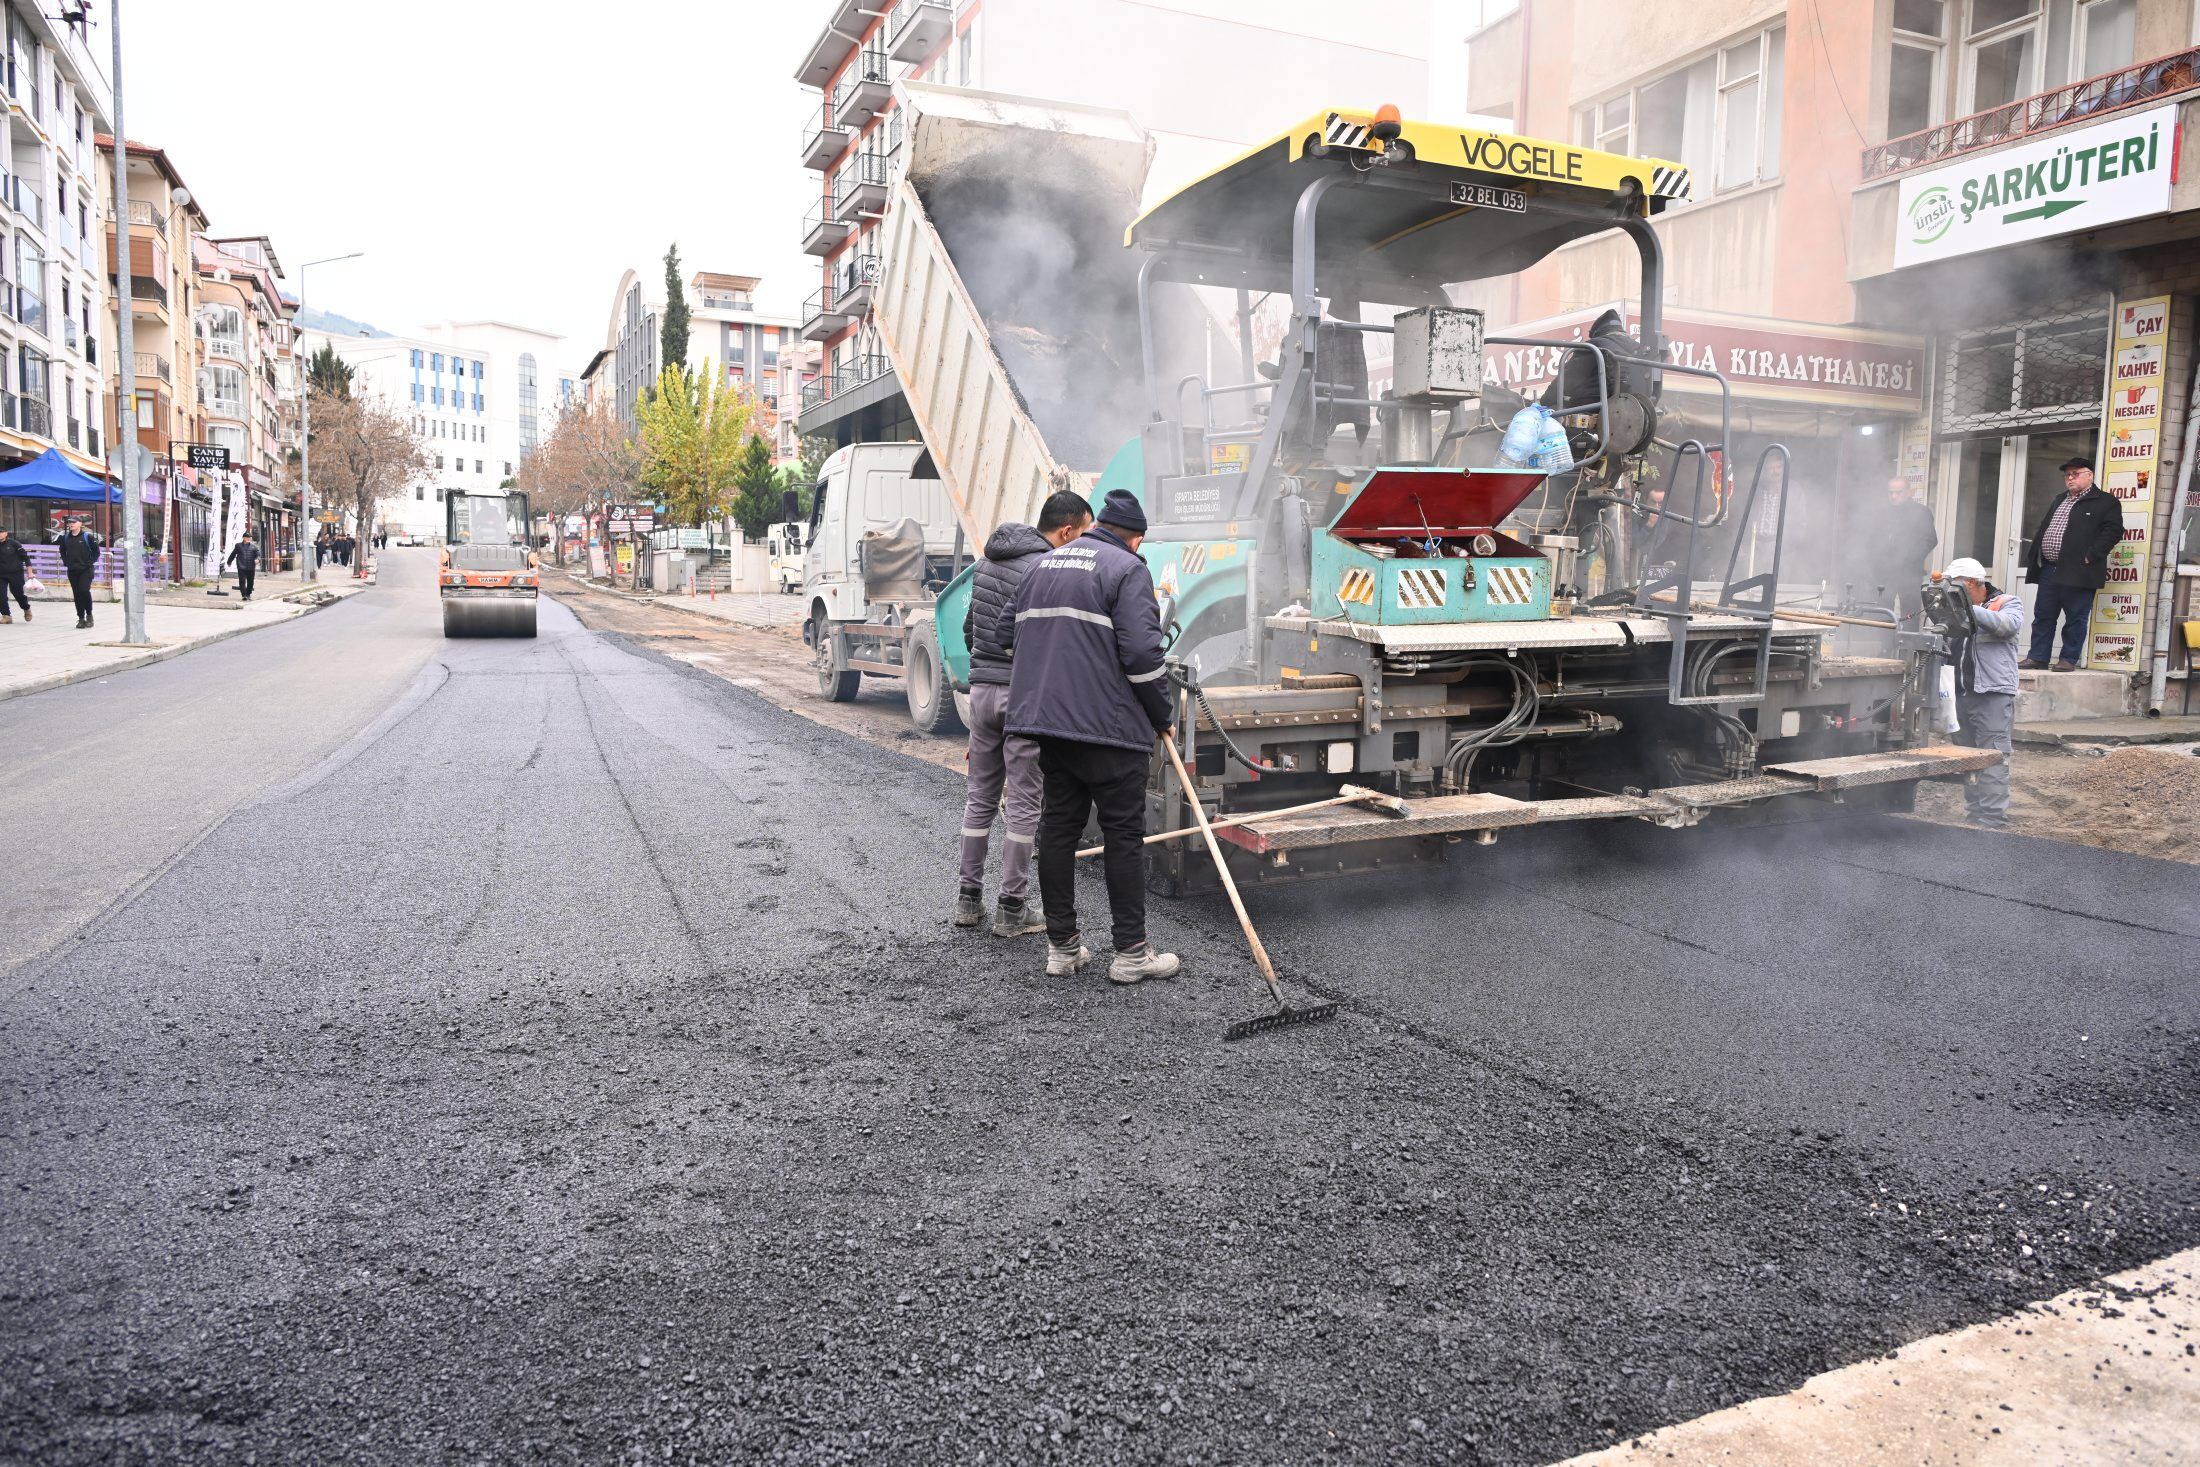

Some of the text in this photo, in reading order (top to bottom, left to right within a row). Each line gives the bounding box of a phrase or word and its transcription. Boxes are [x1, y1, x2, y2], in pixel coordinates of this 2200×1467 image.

[1460, 133, 1582, 181] VÖGELE
[1960, 122, 2159, 224] ŞARKÜTERİ
[1459, 186, 1524, 209] 32 BEL 053
[2136, 316, 2163, 336] ÇAY
[1730, 347, 1914, 391] KIRAATHANESİ
[2118, 361, 2158, 379] KAHVE
[2115, 404, 2156, 418] NESCAFE
[193, 448, 214, 457] CAN
[2111, 444, 2153, 458] ORALET
[193, 456, 225, 465] YAVUZ
[2109, 486, 2137, 499] KOLA
[2123, 528, 2145, 541] NTA
[2105, 567, 2138, 581] SODA
[2112, 595, 2132, 604] BİTKİ
[2120, 605, 2139, 615] ÇAYI
[2095, 635, 2135, 646] KURUYEMİŞ
